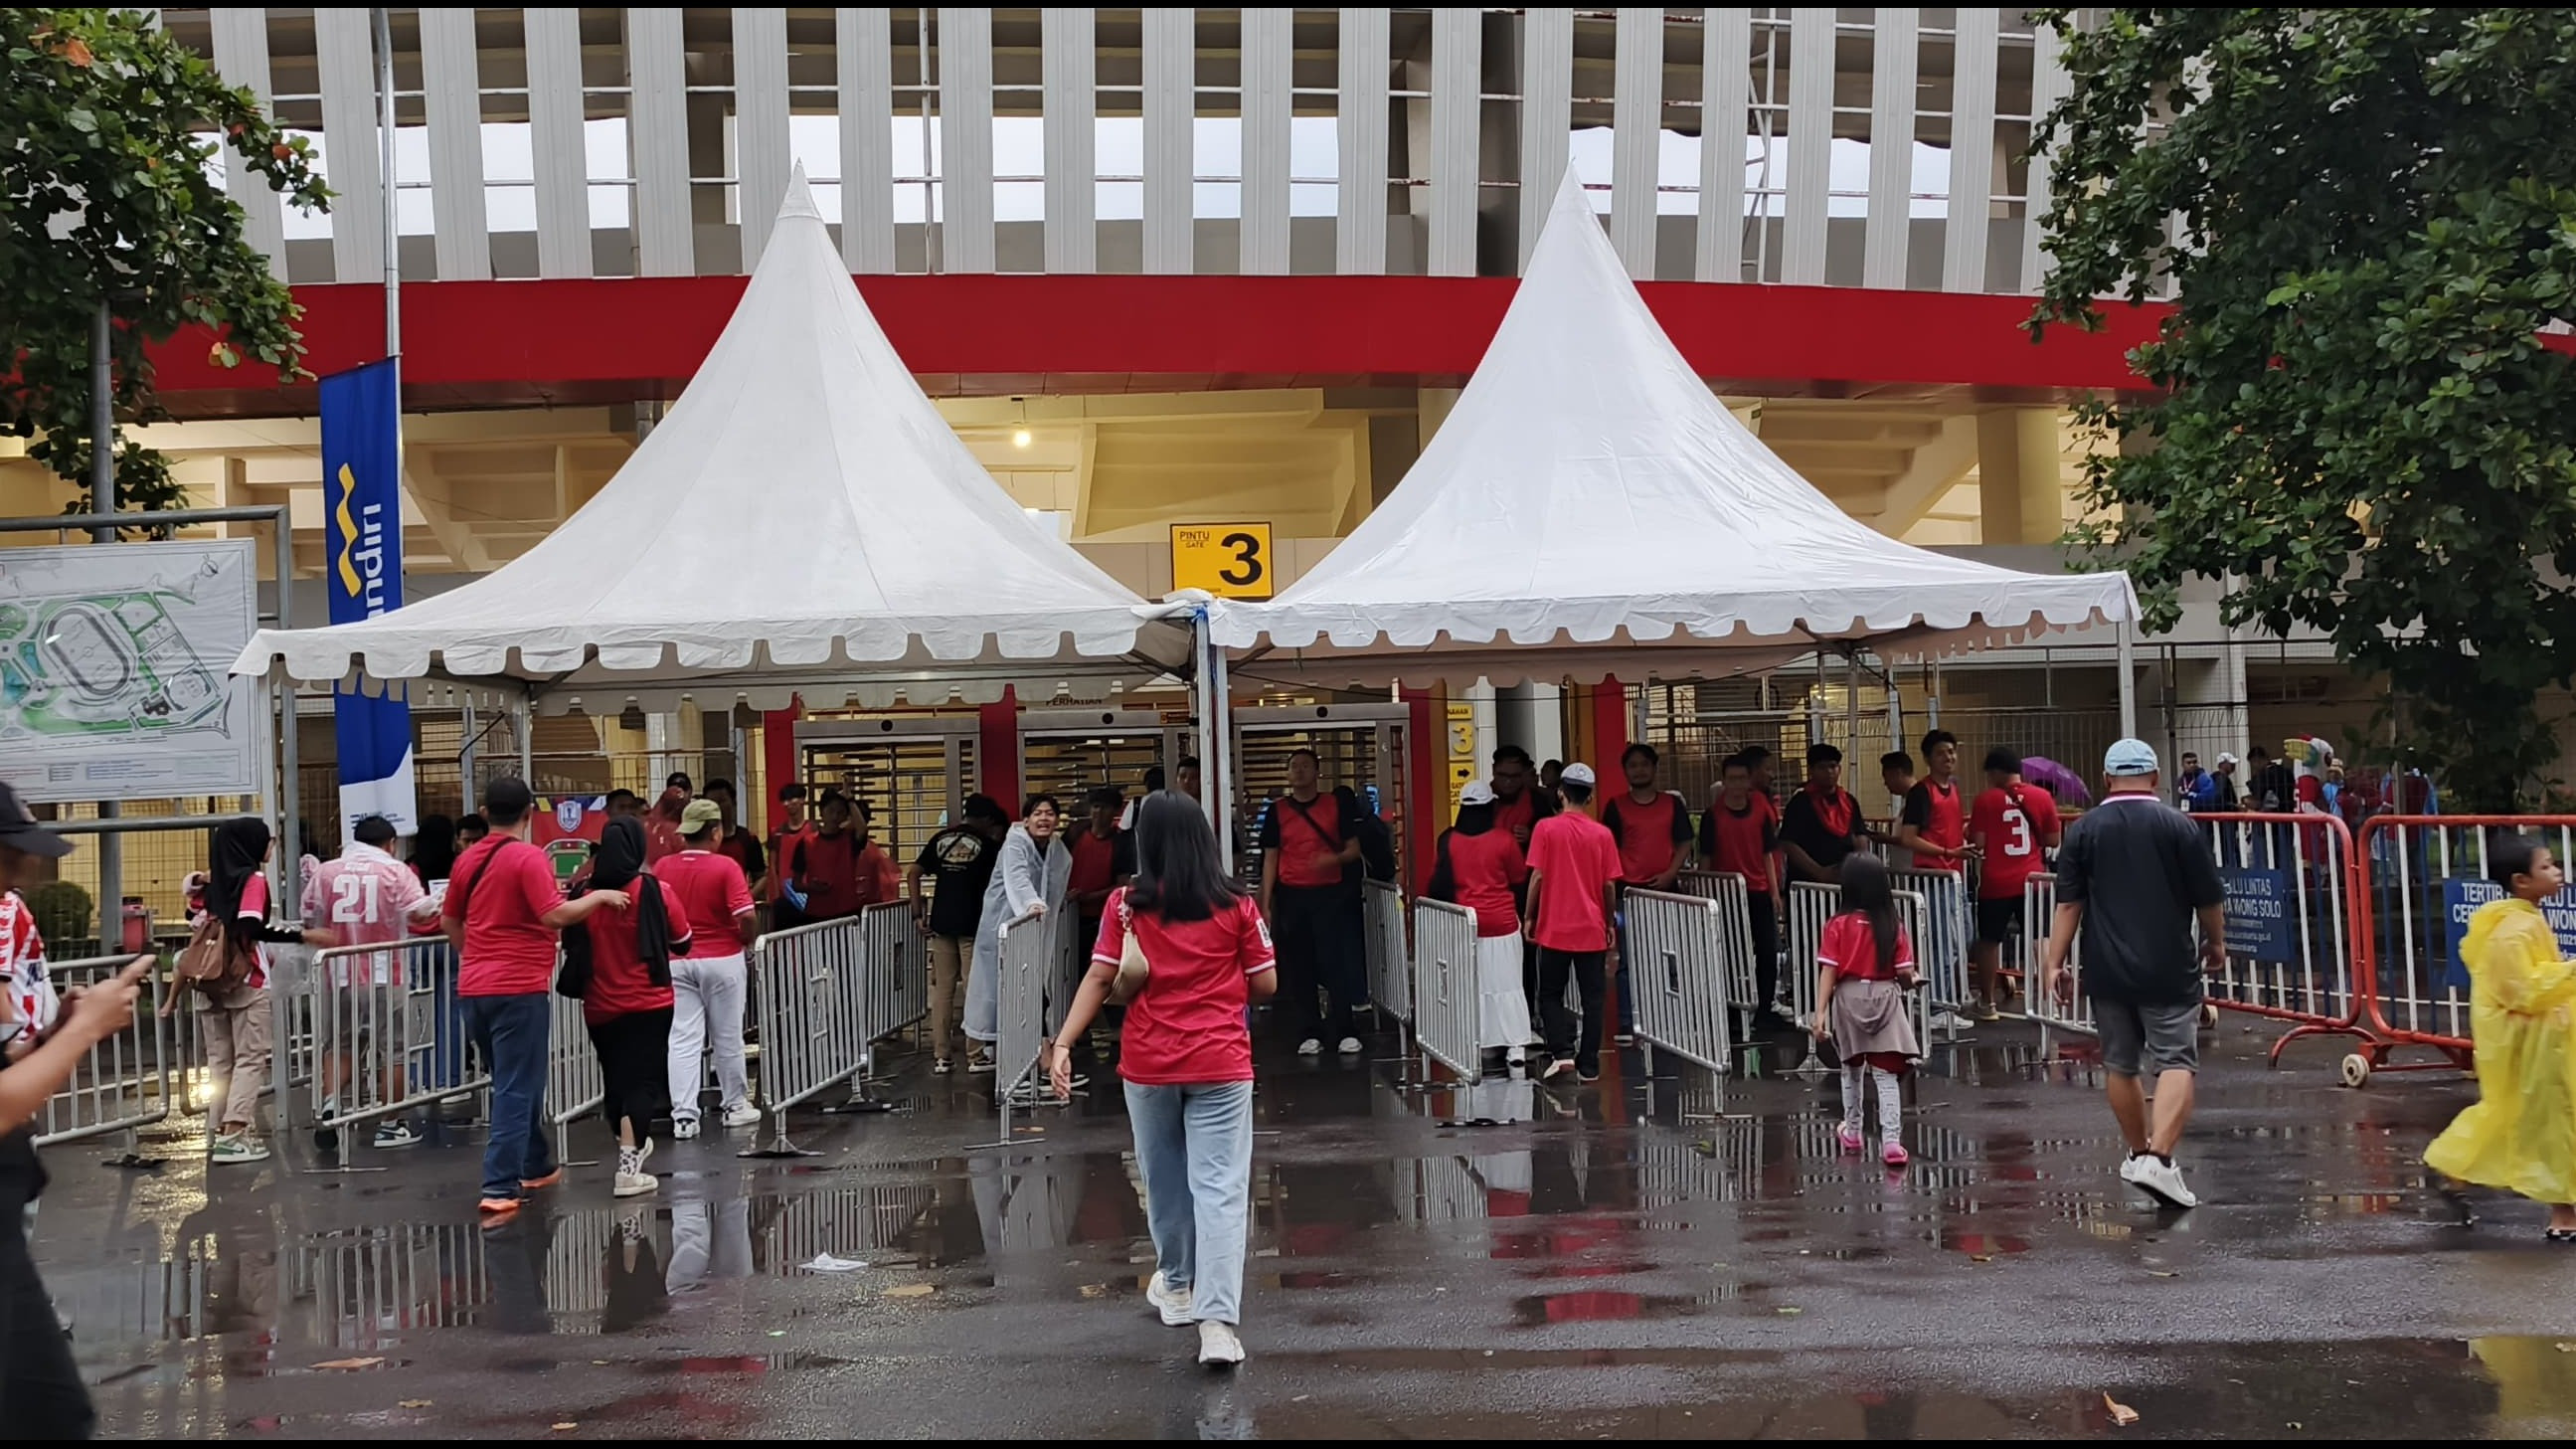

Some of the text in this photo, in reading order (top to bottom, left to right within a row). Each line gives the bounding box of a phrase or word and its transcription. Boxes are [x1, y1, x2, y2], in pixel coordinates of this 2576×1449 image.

[1179, 530, 1210, 540] PINTU
[355, 503, 385, 620] ndiri
[1218, 532, 1263, 586] 3
[1453, 722, 1474, 754] 3
[2002, 809, 2031, 855] 3
[333, 874, 378, 923] 21
[2244, 878, 2272, 896] LINTAS
[2461, 883, 2503, 902] TERTIB
[2233, 898, 2259, 917] WONG
[2259, 900, 2282, 918] SOLO
